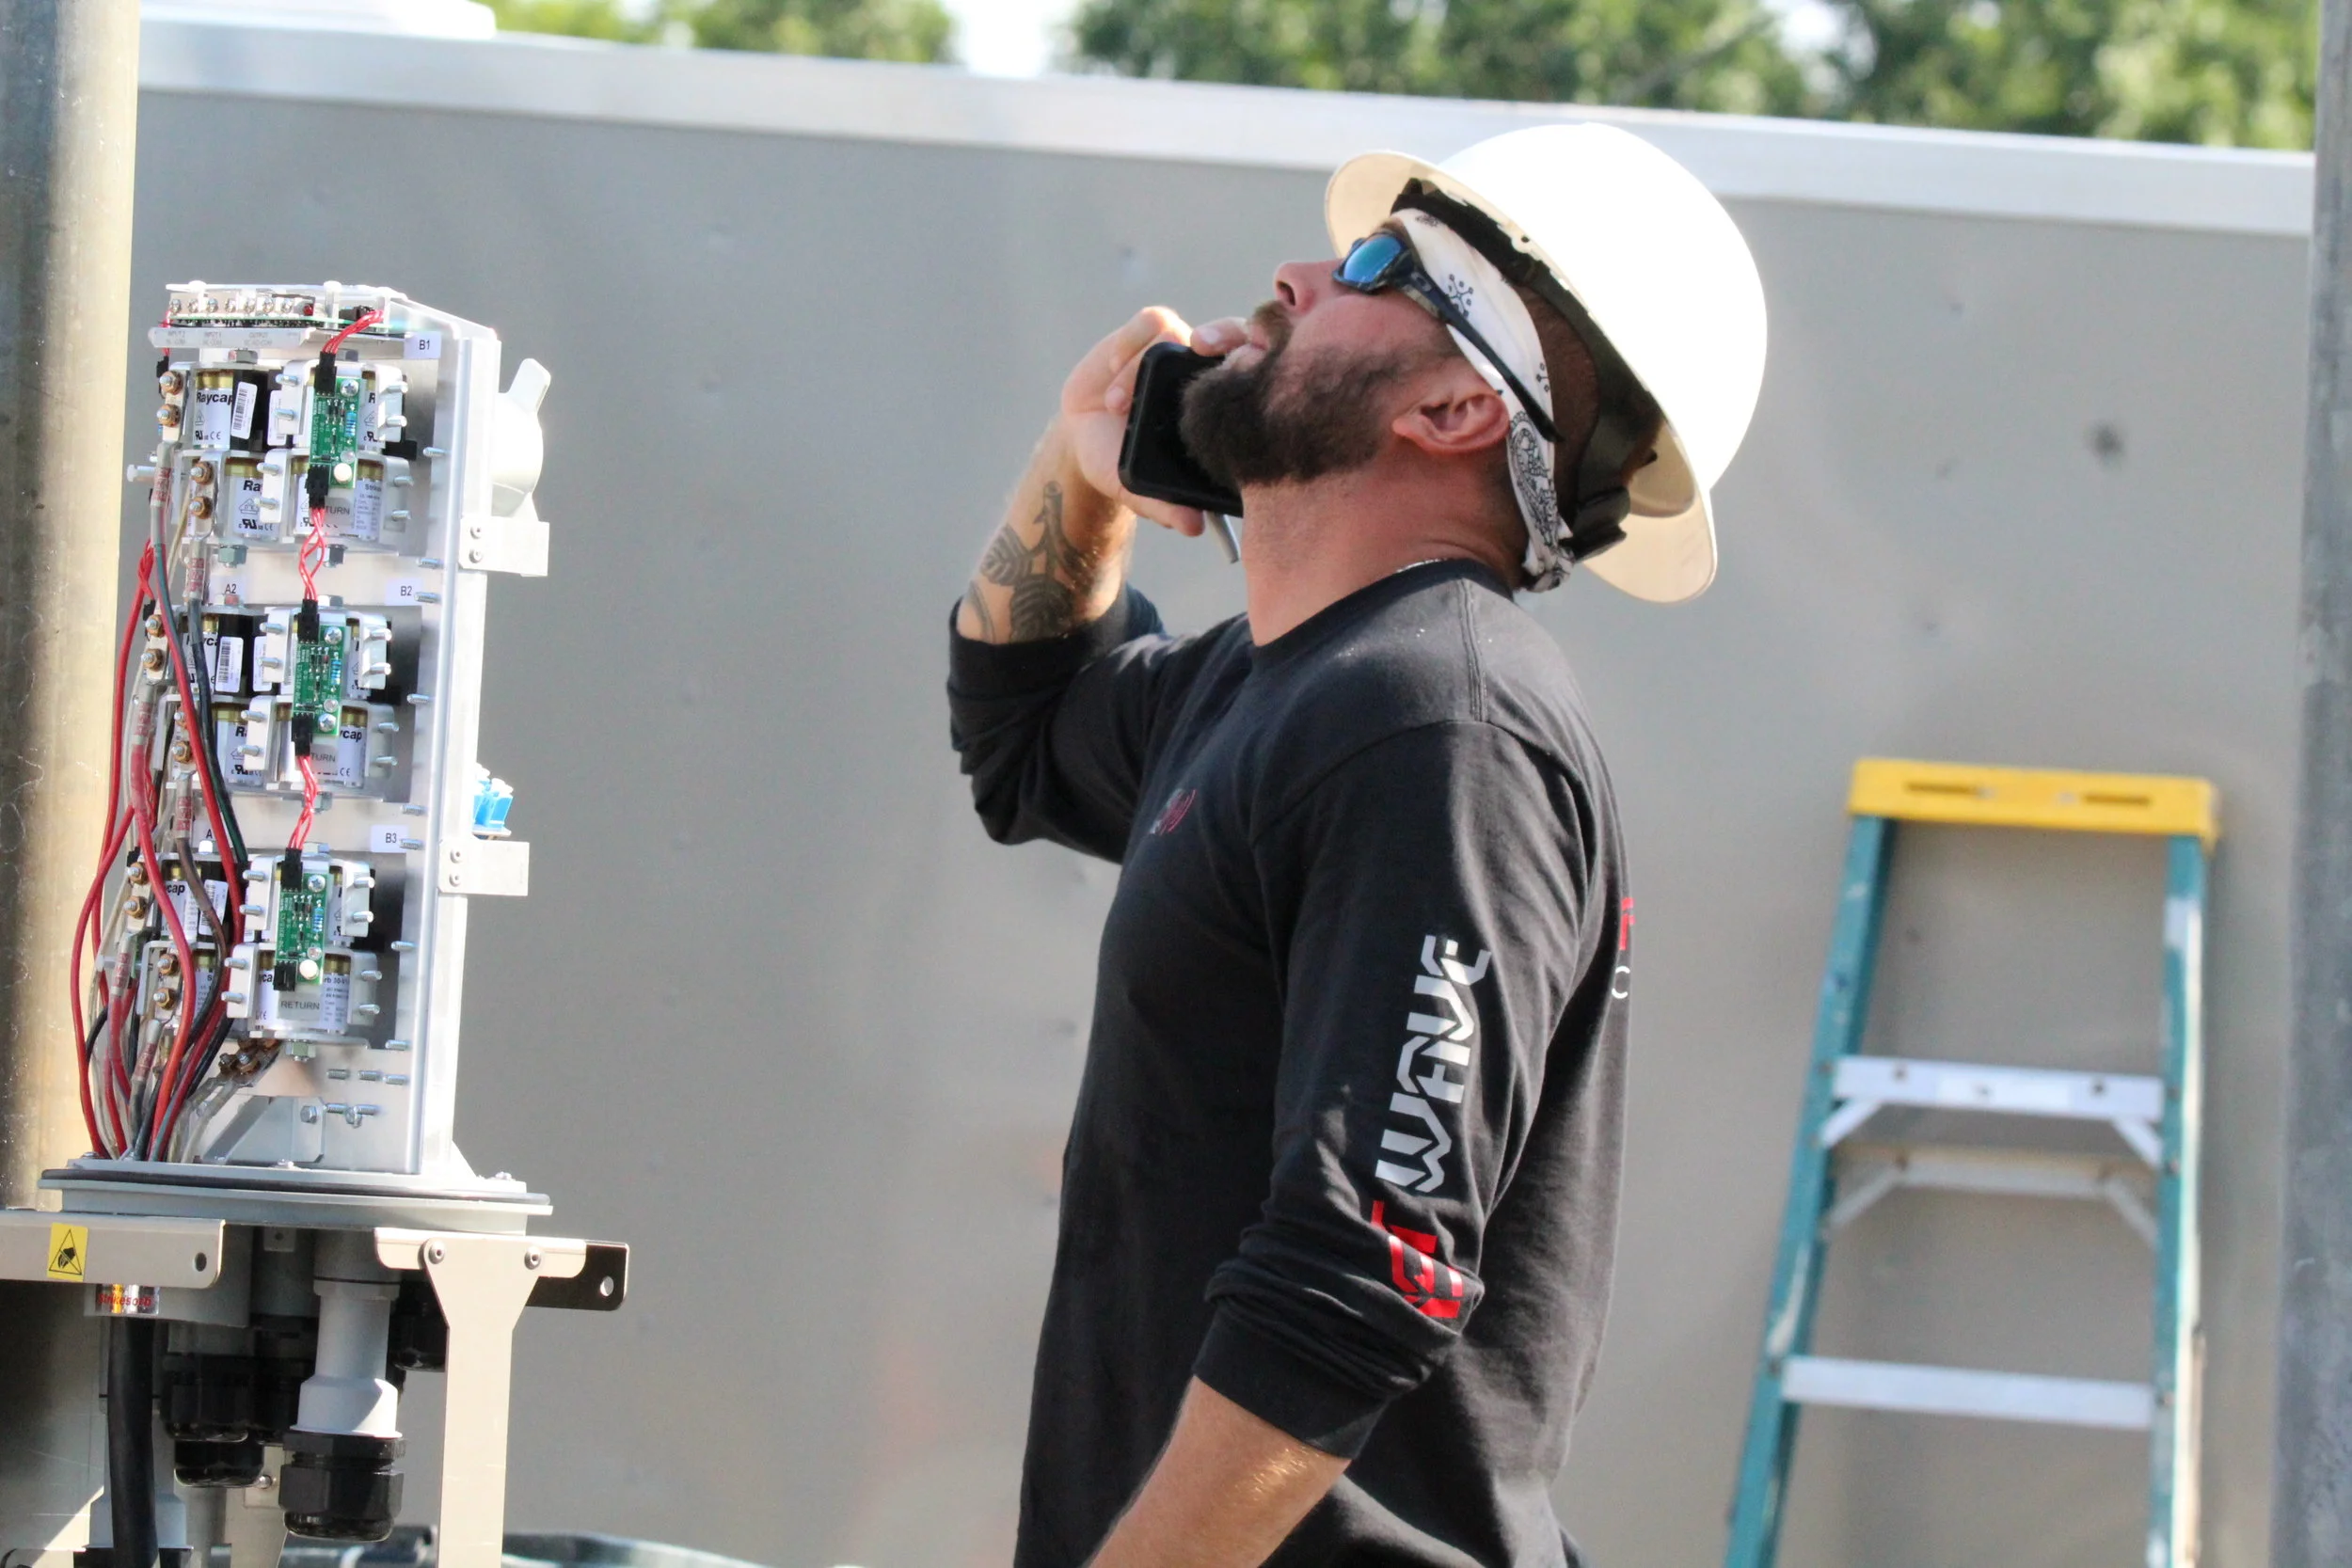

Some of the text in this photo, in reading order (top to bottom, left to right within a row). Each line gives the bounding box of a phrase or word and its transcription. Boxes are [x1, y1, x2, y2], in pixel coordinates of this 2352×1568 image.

[419, 339, 430, 351] B1
[326, 505, 351, 515] TURN
[224, 583, 237, 594] A2
[400, 585, 413, 596] B2
[310, 752, 336, 762] TURN
[385, 832, 397, 844] B3
[280, 1000, 321, 1010] RETURN
[1375, 934, 1492, 1194] WAVE
